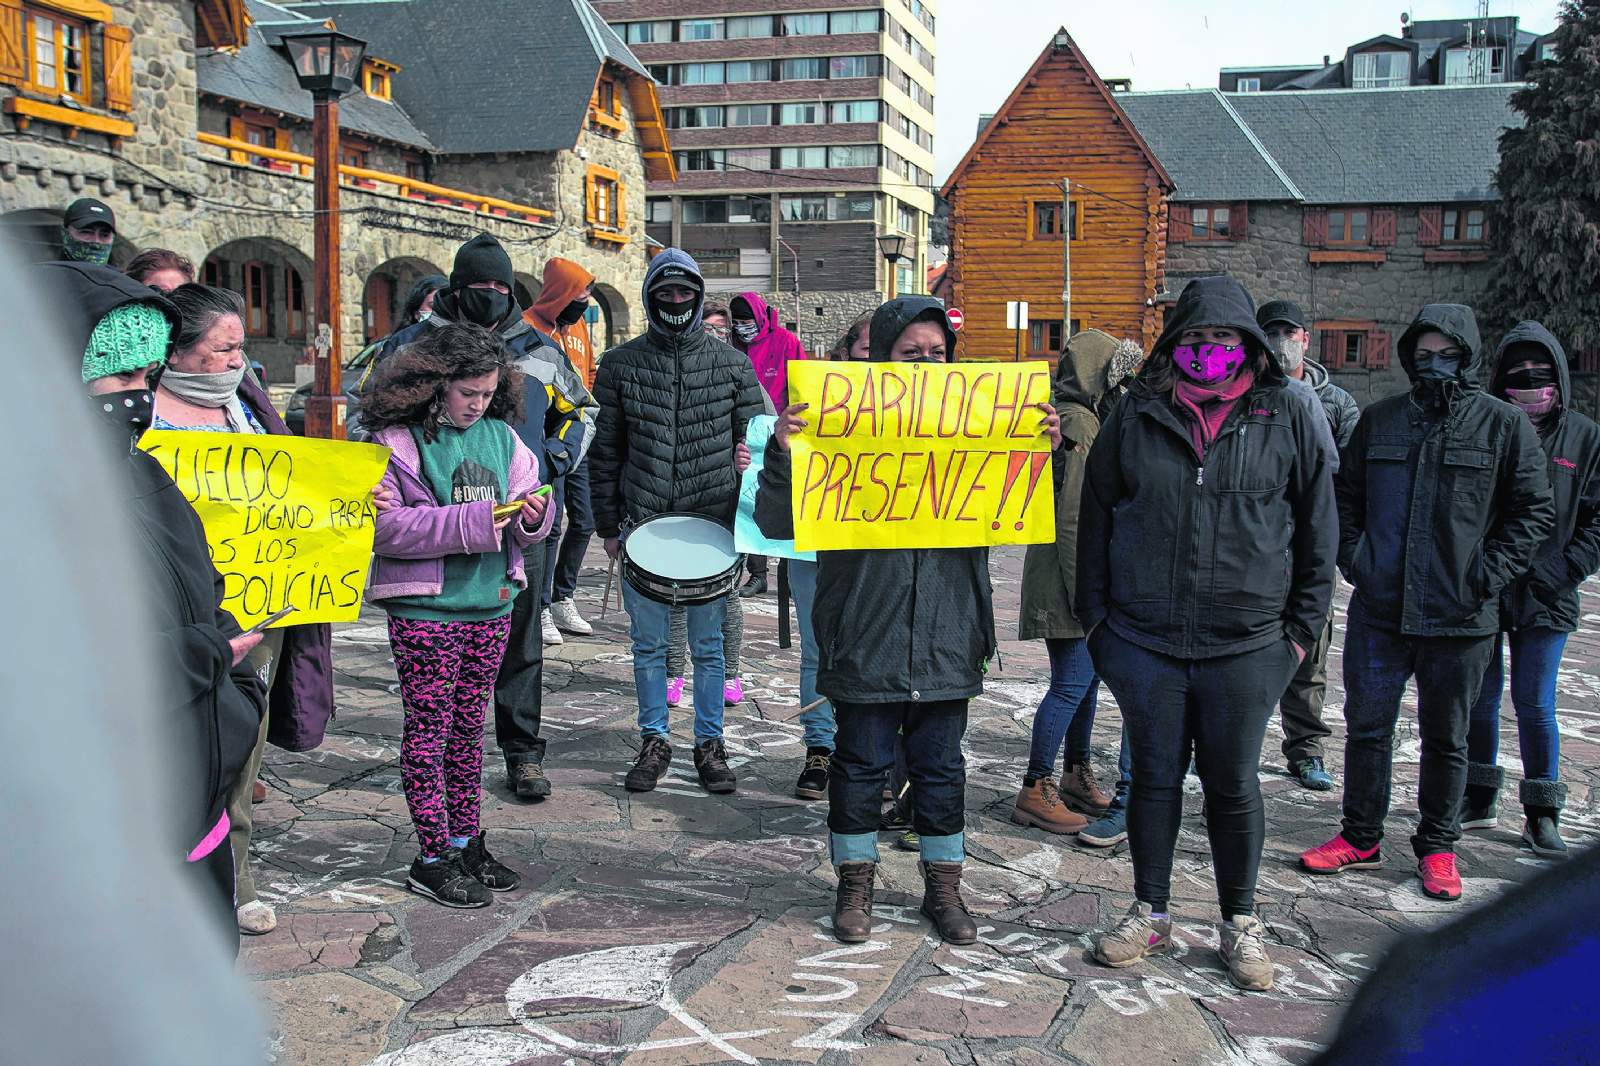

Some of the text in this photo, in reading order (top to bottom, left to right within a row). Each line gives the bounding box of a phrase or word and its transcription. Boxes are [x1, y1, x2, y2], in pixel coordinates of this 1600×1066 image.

[658, 308, 693, 325] WHATEVER
[146, 444, 293, 504] UELDO
[800, 449, 1051, 531] PRESENTE!!
[329, 498, 376, 529] PARA
[253, 538, 298, 564] LOS
